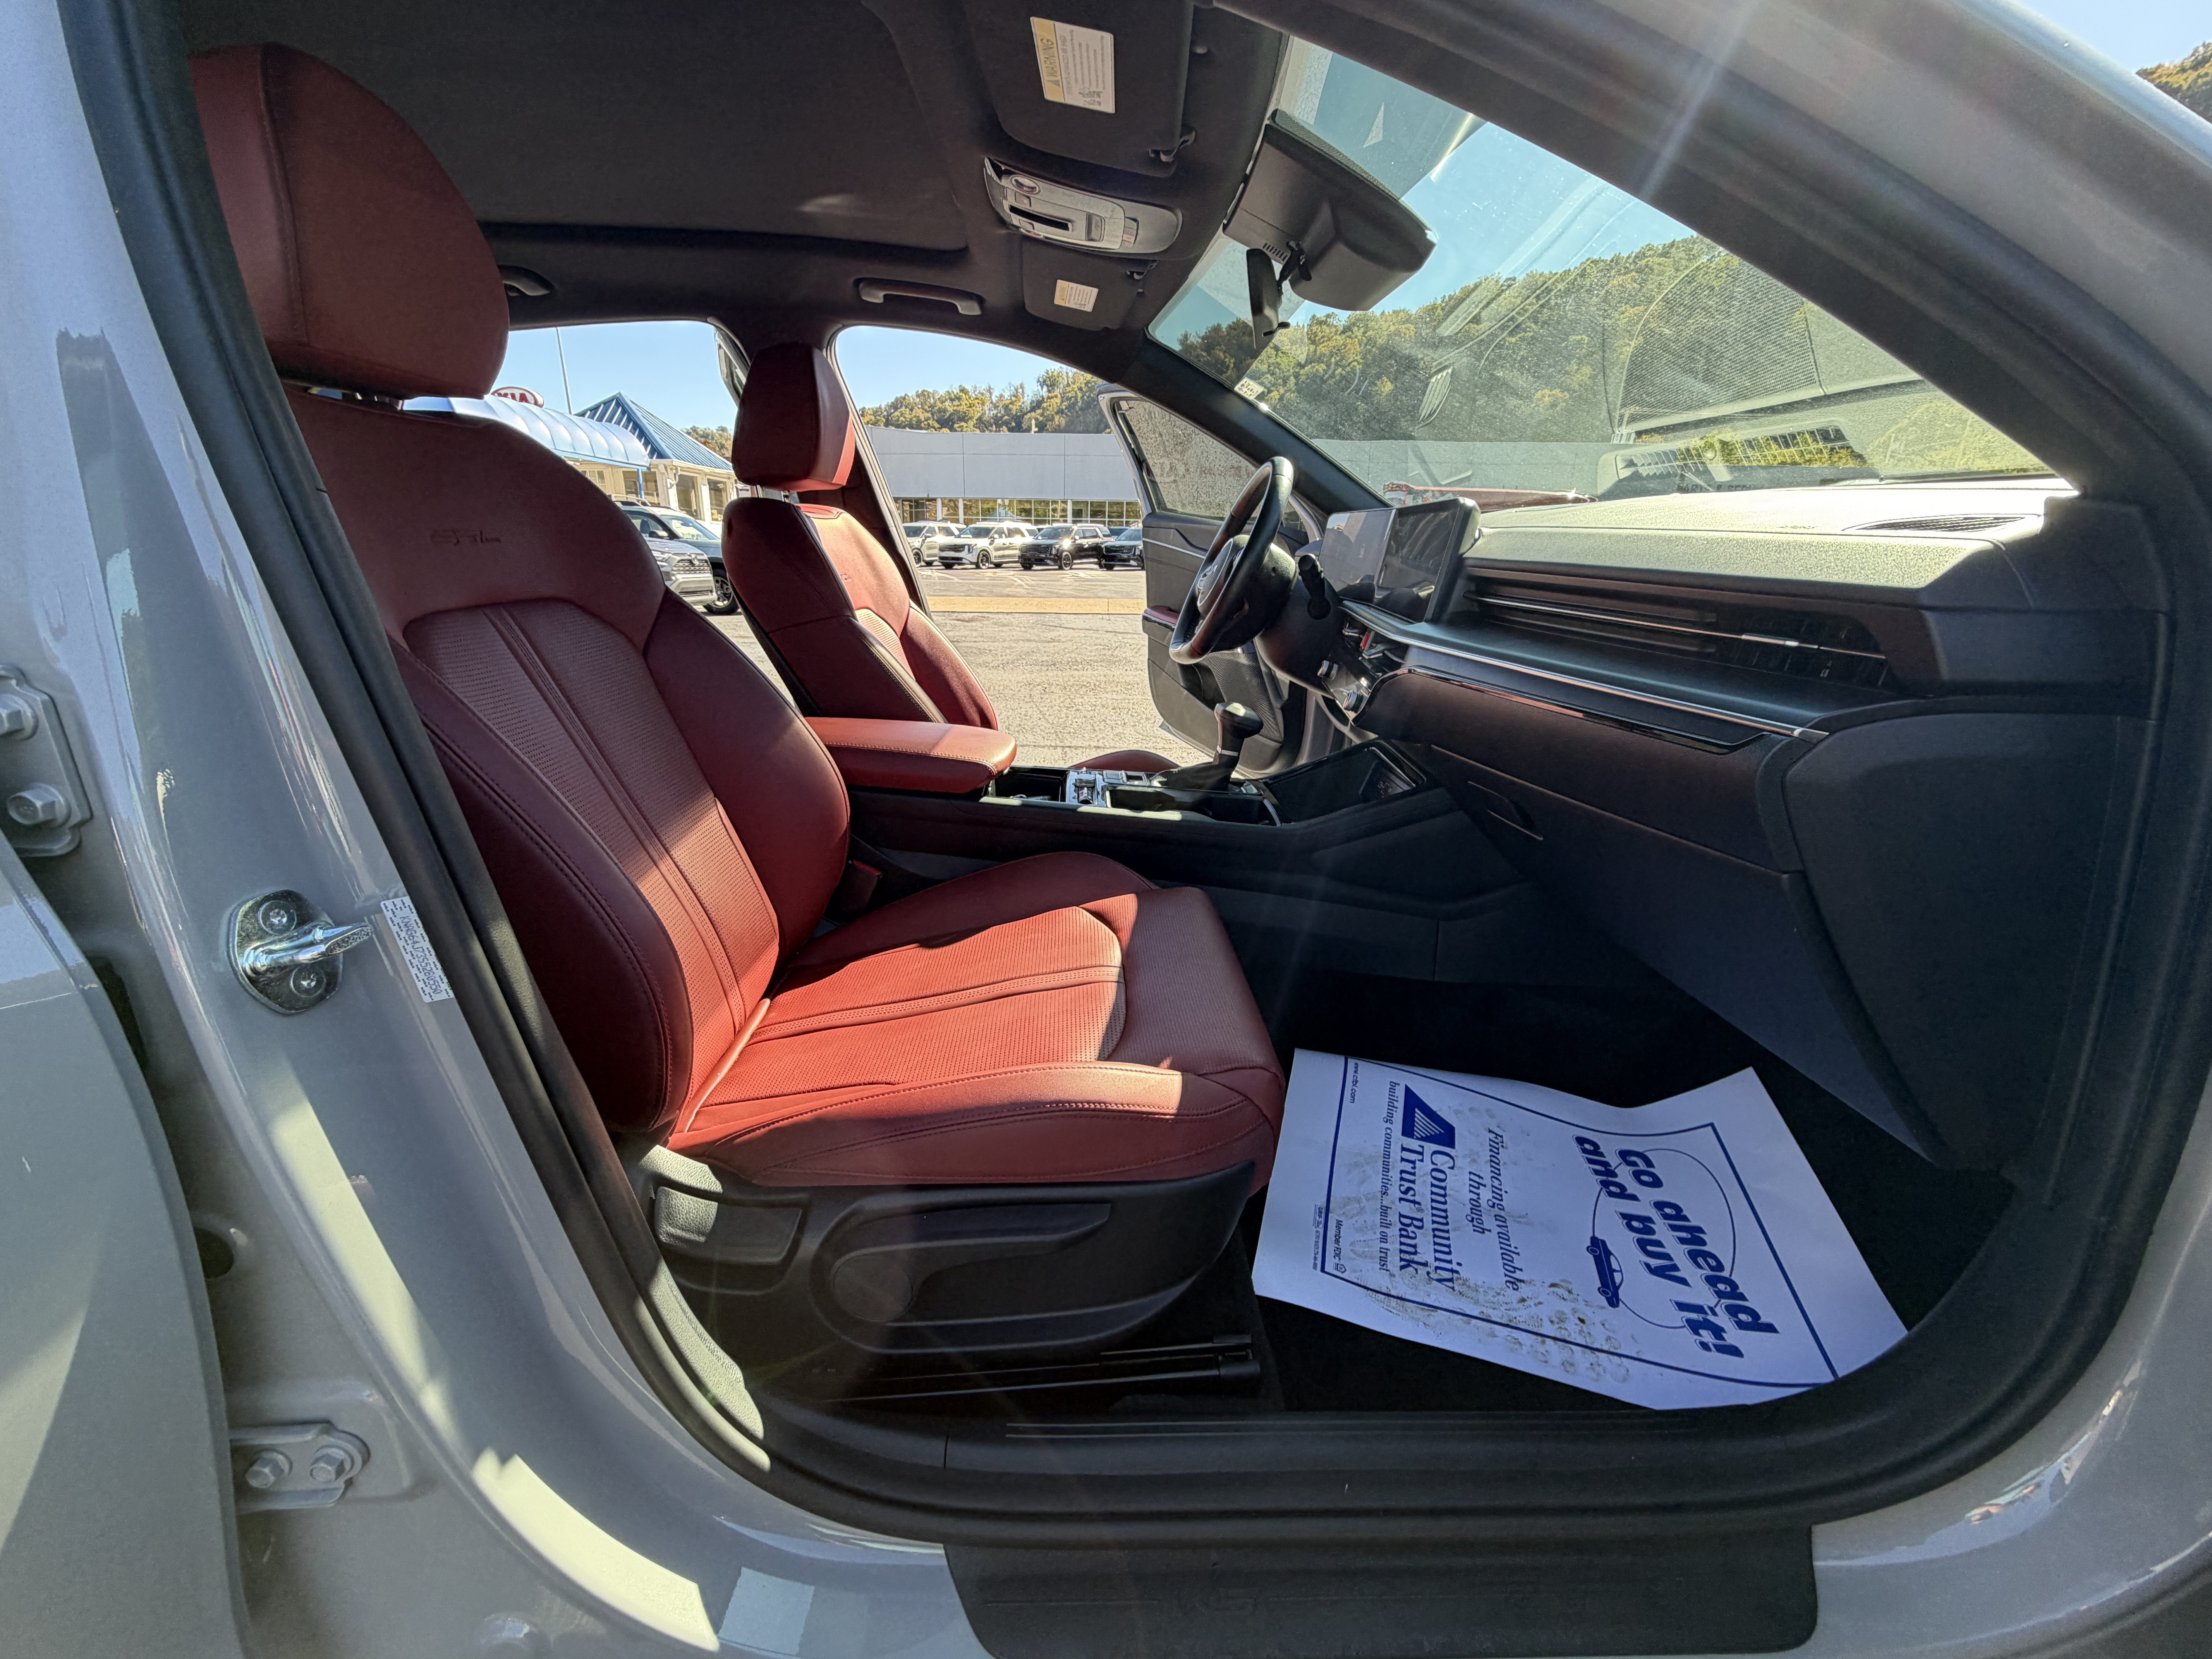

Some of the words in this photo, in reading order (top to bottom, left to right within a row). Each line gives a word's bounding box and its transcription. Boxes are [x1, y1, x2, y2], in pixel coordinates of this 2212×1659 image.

[1040, 38, 1058, 77] WARNING
[1383, 1080, 1400, 1125] building
[1487, 1127, 1508, 1212] Financing
[1334, 1219, 1343, 1247] Member
[1426, 1149, 1463, 1292] Community
[1465, 1171, 1492, 1235] through
[1333, 1247, 1342, 1261] FDIC
[1379, 1231, 1388, 1244] on
[1379, 1247, 1391, 1273] trust
[1398, 1212, 1429, 1275] Bank
[1494, 1214, 1525, 1292] available
[1572, 1134, 1641, 1202] and
[1614, 1210, 1692, 1288] buy
[1669, 1298, 1745, 1358] it!
[1614, 1148, 1664, 1188] Go
[1649, 1199, 1781, 1334] ahead
